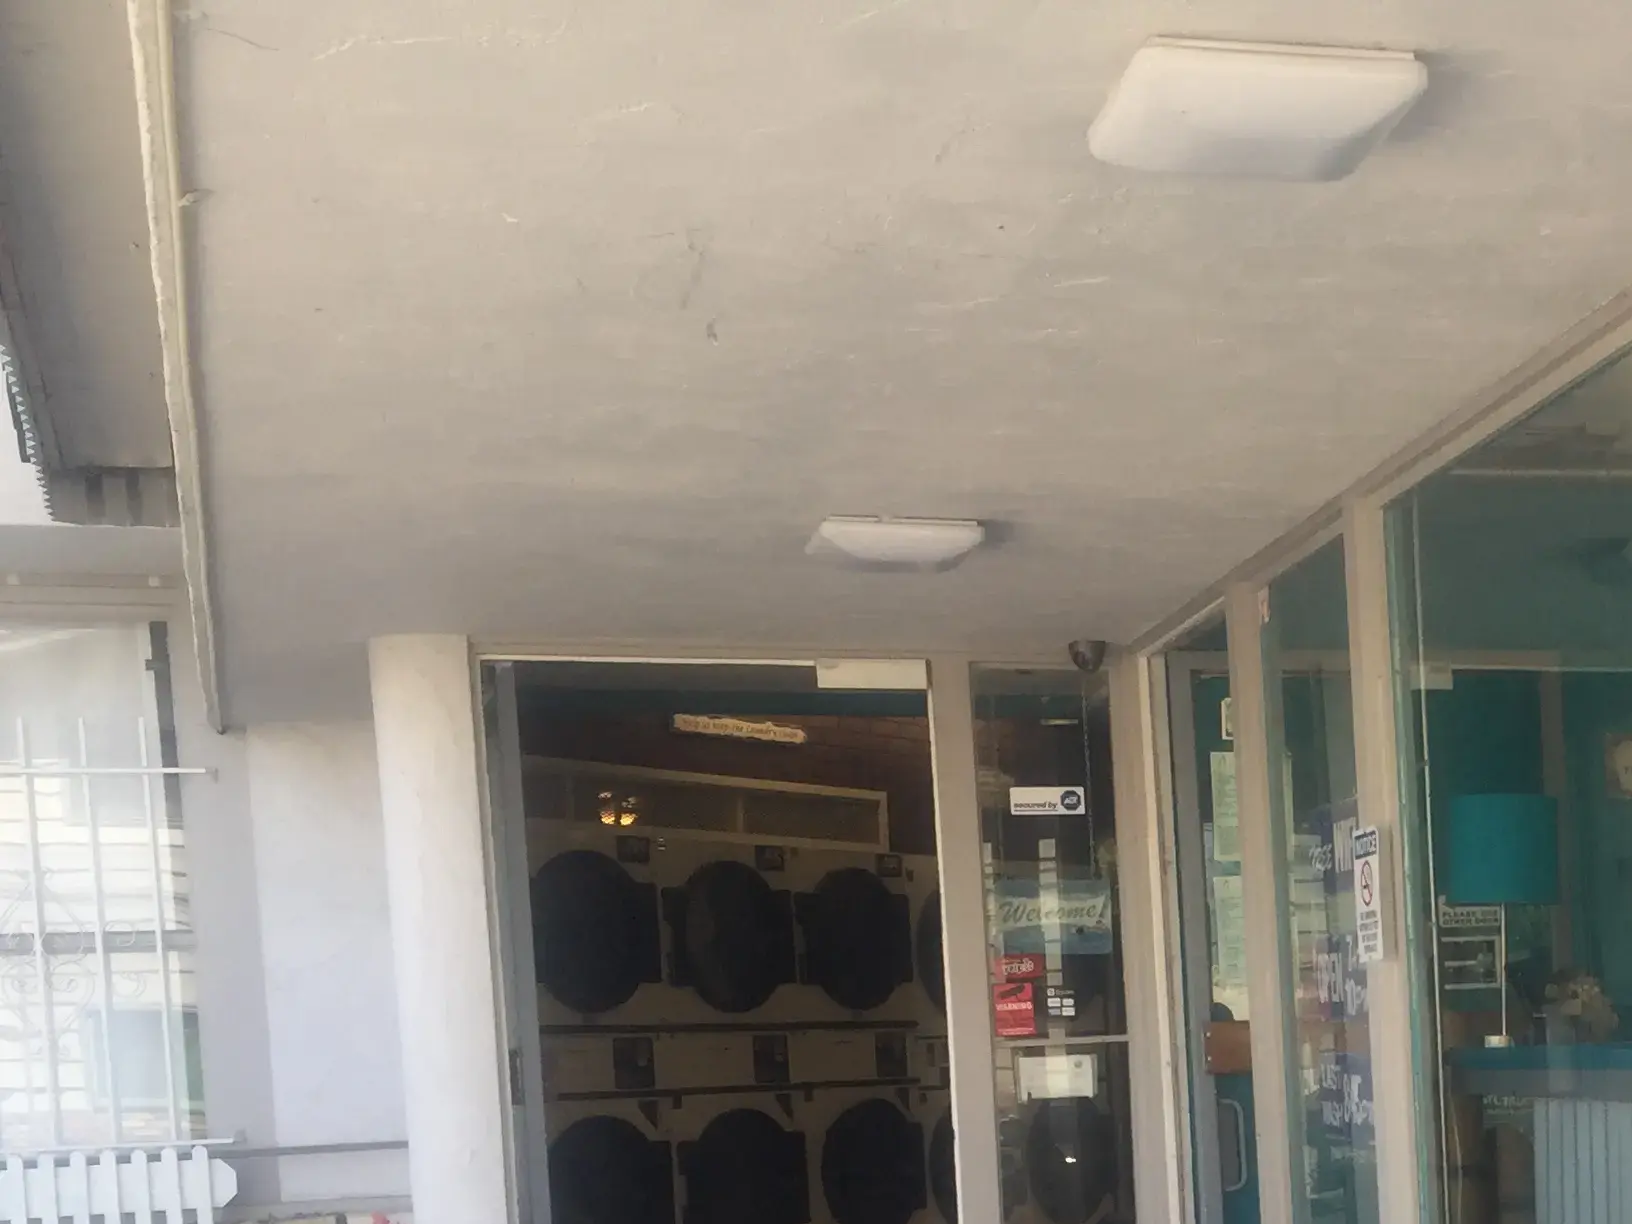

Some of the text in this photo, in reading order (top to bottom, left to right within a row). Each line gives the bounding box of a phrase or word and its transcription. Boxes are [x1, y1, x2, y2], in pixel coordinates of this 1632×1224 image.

[1013, 801, 1046, 809] secured
[1047, 801, 1058, 810] by
[1355, 834, 1377, 855] NOTICE
[1442, 909, 1477, 918] PLEASE
[1442, 918, 1473, 926] OTHER
[995, 1001, 1033, 1011] WARNING
